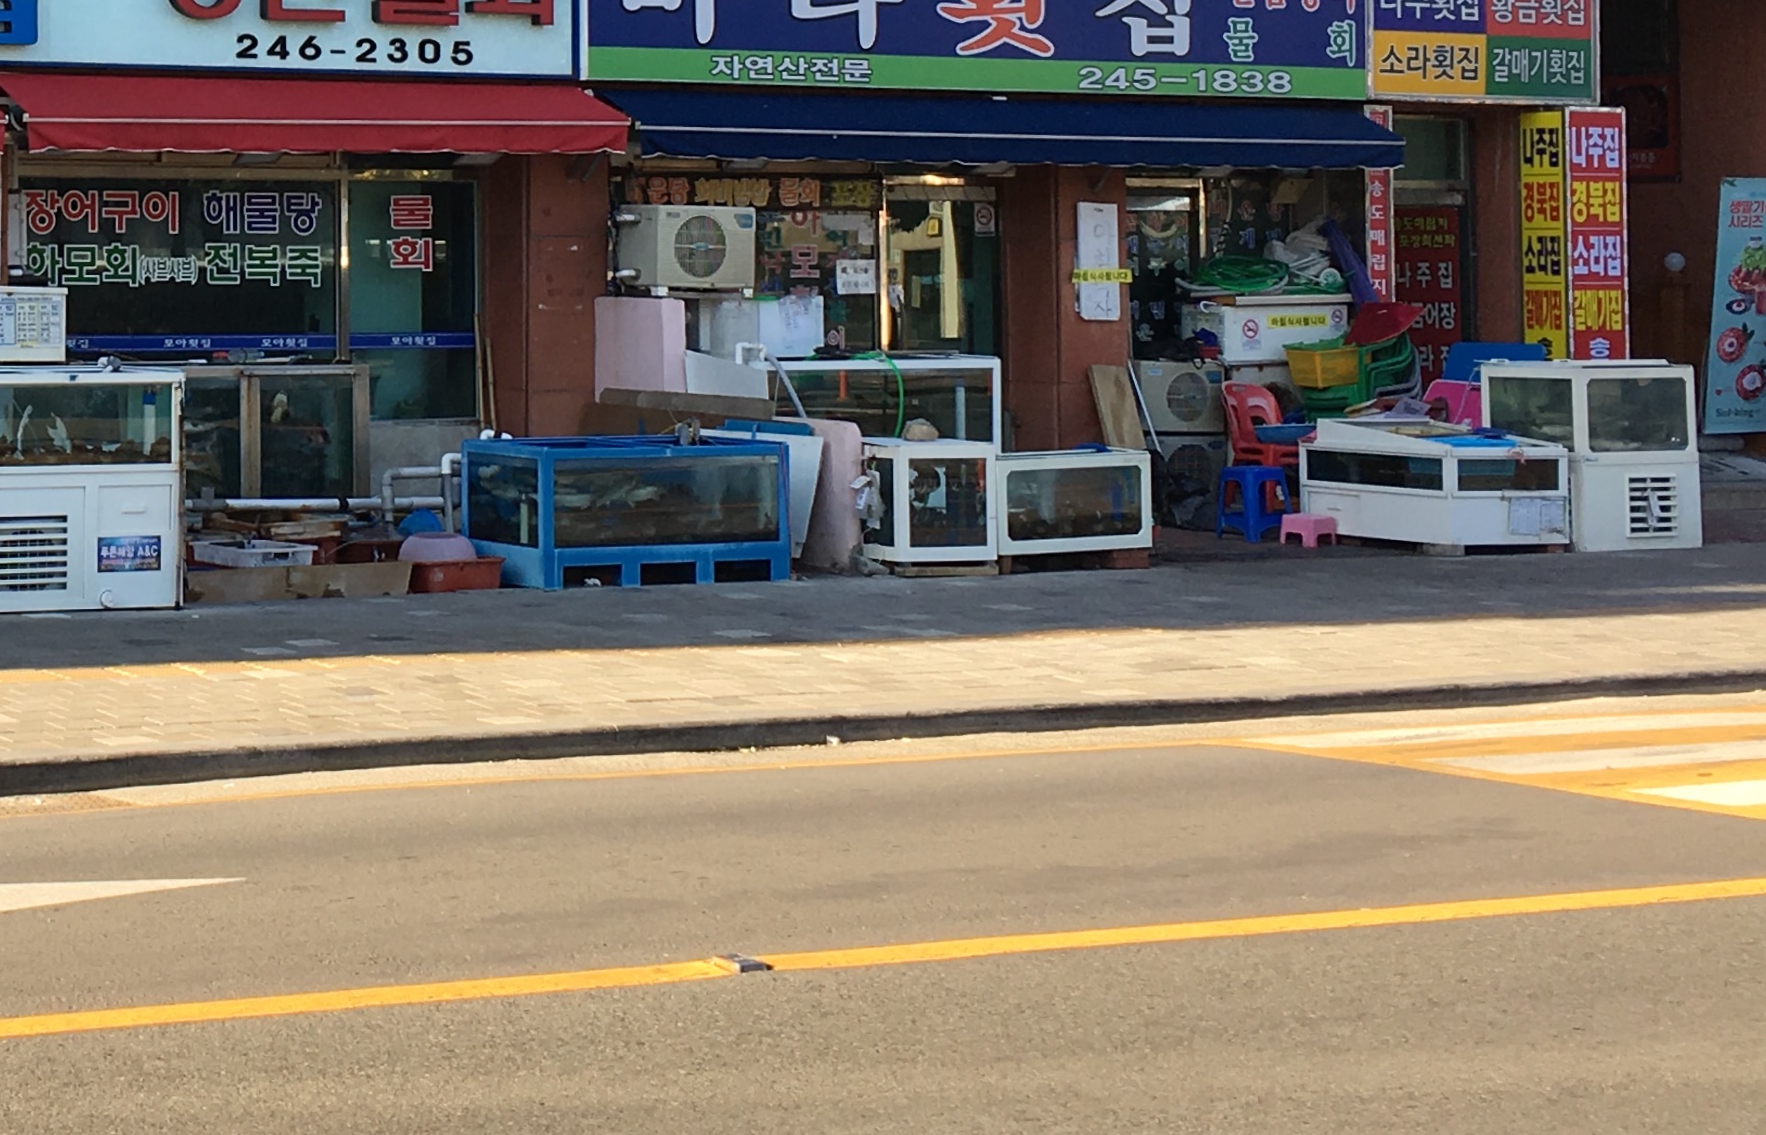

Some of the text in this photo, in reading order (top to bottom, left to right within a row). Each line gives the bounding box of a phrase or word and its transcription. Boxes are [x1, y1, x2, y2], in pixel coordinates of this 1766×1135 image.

[235, 33, 475, 66] 246-2305
[709, 53, 874, 84] 자연산전문
[1379, 45, 1585, 85] 소라횟집 갈매기횟집
[1078, 66, 1293, 94] 245-1838
[1523, 128, 1560, 168] 나주집
[1570, 127, 1620, 168] 나주집
[24, 189, 322, 236] 장어구이 해물탕
[1523, 181, 1561, 223] 경북집
[1572, 181, 1621, 223] 경북집
[388, 194, 434, 273] 물회
[1369, 180, 1387, 295] 송도매립지
[203, 243, 323, 287] 전복죽
[1525, 235, 1562, 276] 소라집
[1573, 235, 1622, 276] 소라집
[1574, 289, 1622, 331] 갈매기집
[137, 545, 158, 557] A&C
